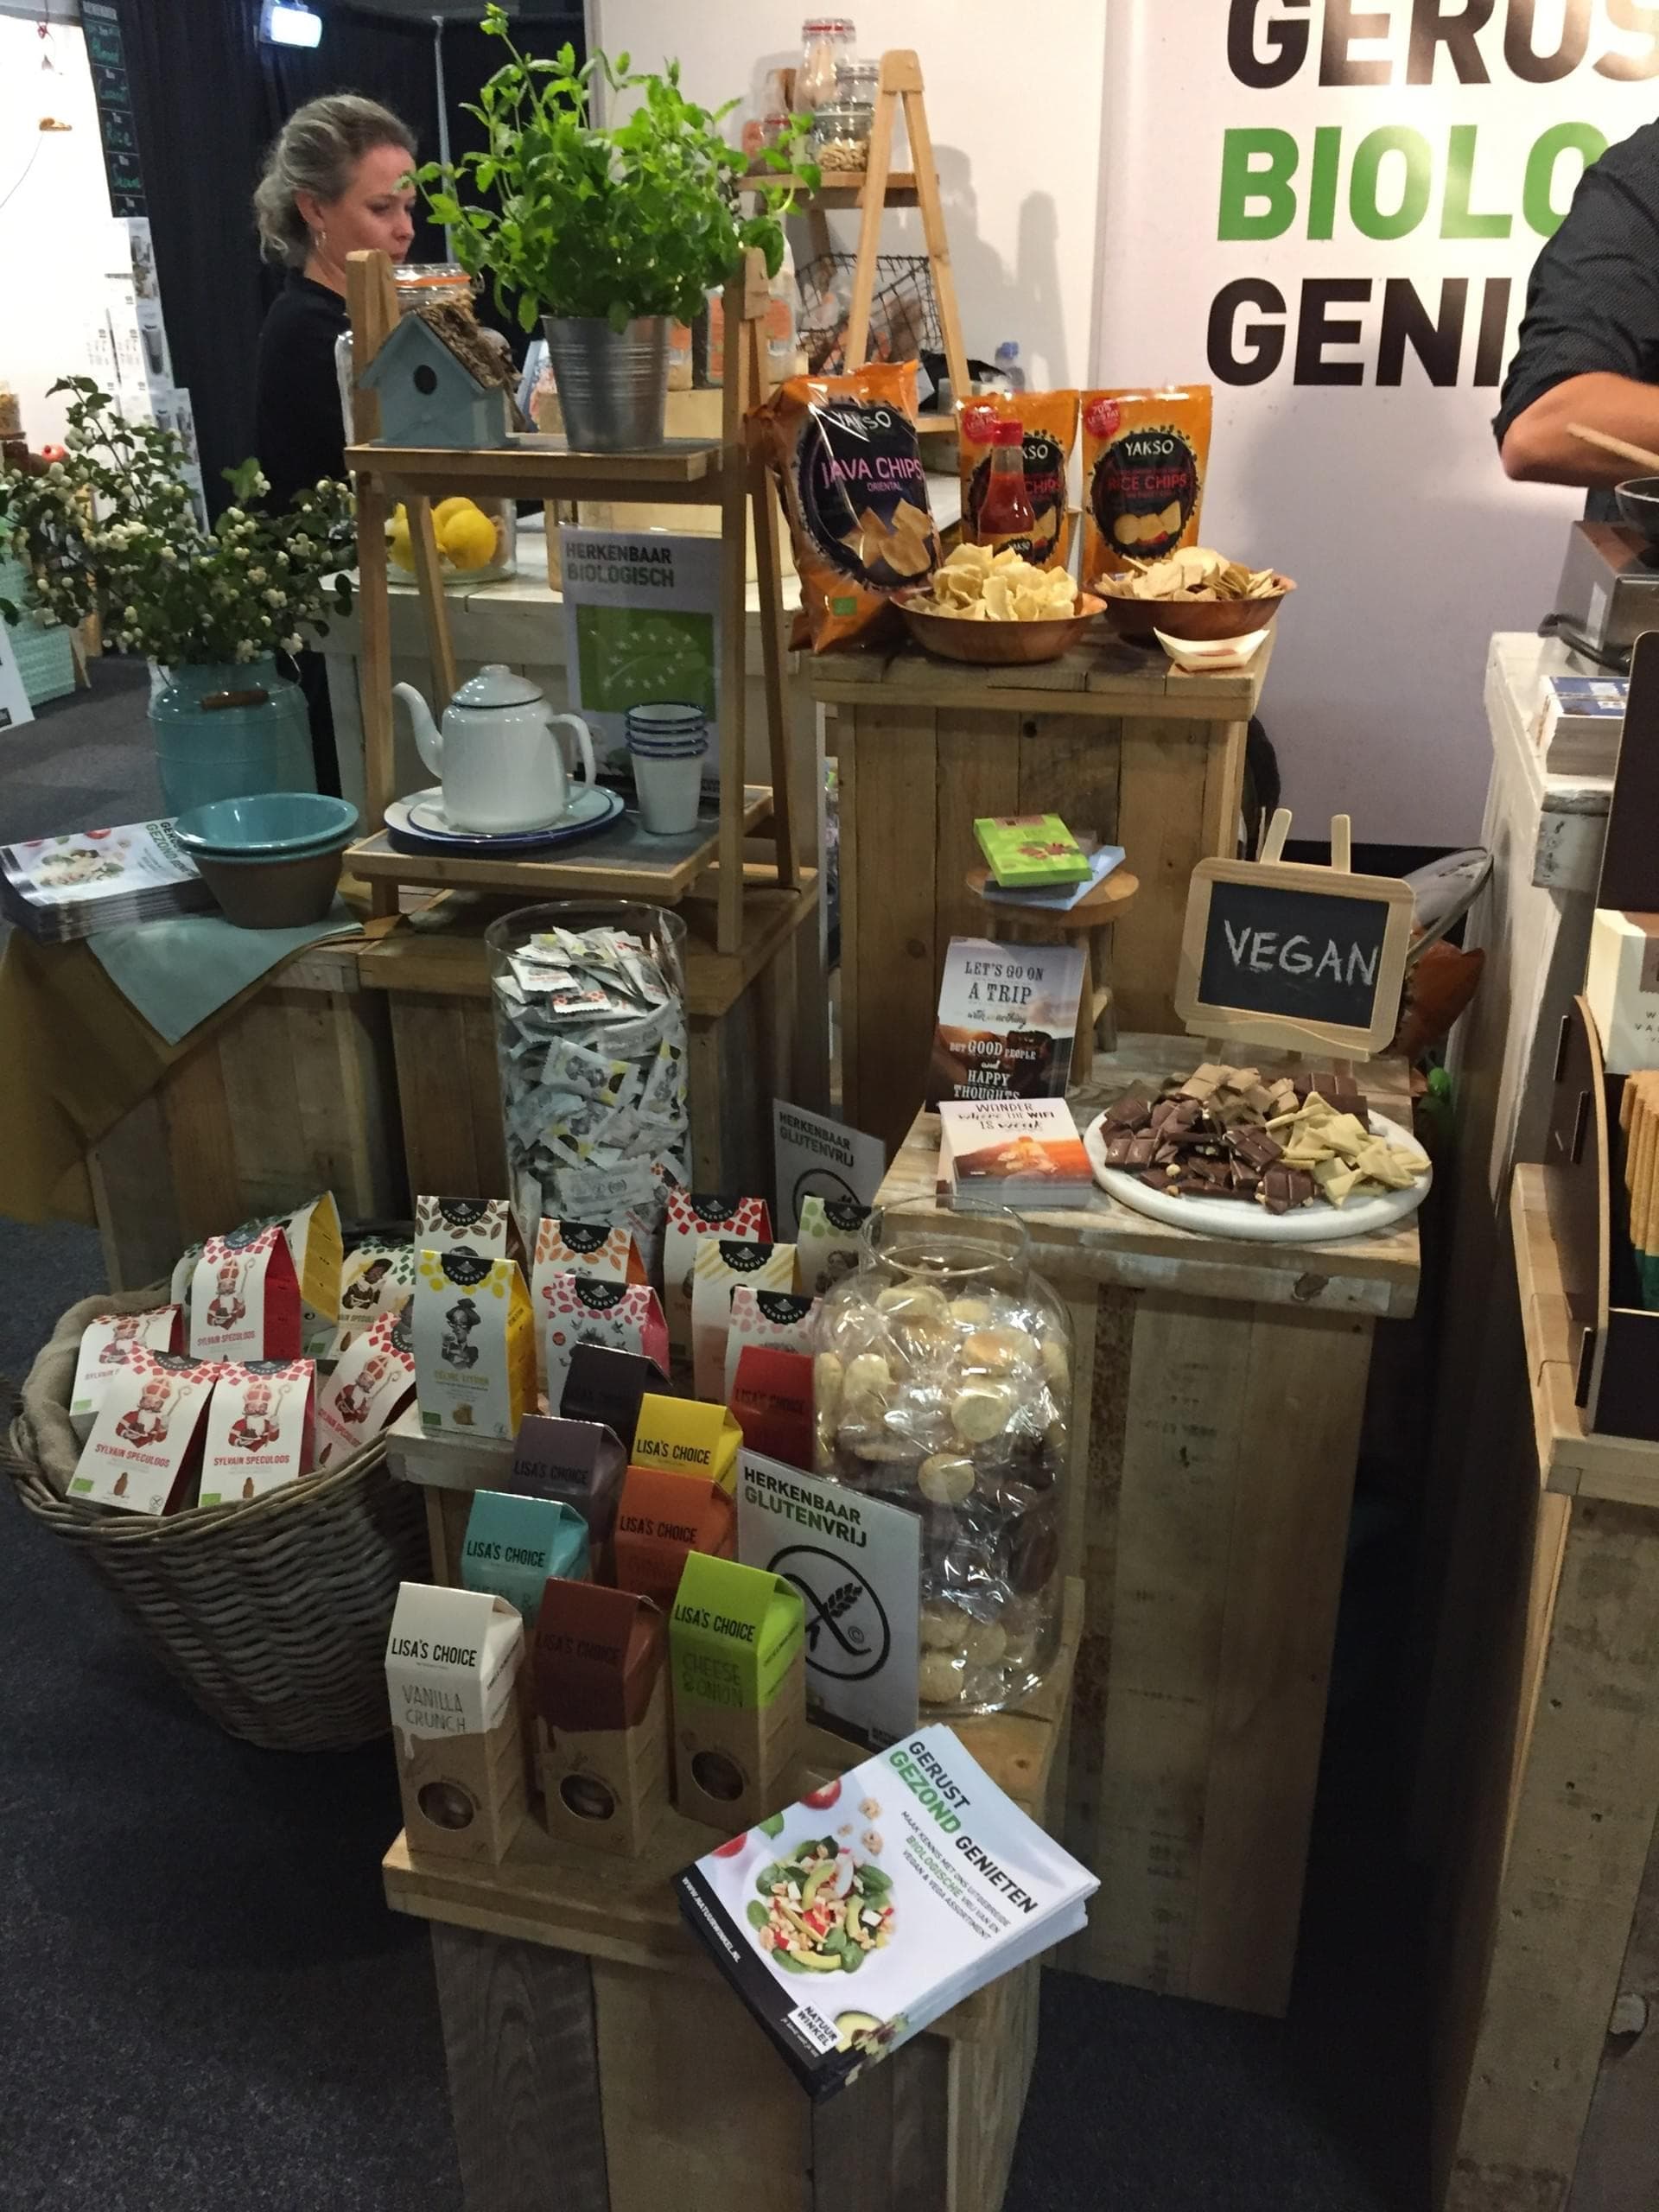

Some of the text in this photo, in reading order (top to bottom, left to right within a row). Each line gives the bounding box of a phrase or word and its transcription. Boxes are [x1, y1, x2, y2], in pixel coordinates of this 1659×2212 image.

[831, 410, 892, 431] YAKSO
[1125, 439, 1174, 456] YAKSO
[822, 457, 926, 489] JAVA CHIPS
[1145, 474, 1187, 491] CHIPS
[566, 542, 672, 564] HERKENBAAR
[567, 563, 675, 588] BIOLOGISCH
[1224, 918, 1379, 987] VEGAN
[964, 961, 1044, 982] LET'S GO ON
[968, 982, 1033, 1005] A TRIP
[968, 1039, 1003, 1057] GOOD
[1004, 1048, 1037, 1061] PEOPLE
[953, 1084, 1020, 1101] THOUGHTS
[968, 1070, 1011, 1087] HAPPY
[779, 1111, 851, 1151] HERKENBAAR
[779, 1126, 855, 1167] GLUTENVRIJ
[94, 1444, 171, 1468] SYLVAIN SPECULOOS
[213, 1455, 290, 1466] SYLVAIN SPECULOOS
[636, 1438, 712, 1465] LISA'S CHOICE
[550, 1465, 589, 1485] CHOICE
[744, 1465, 862, 1526] HERKENBAAR
[619, 1515, 699, 1545] LISA'S CHOICE
[744, 1484, 868, 1549] GLUTENVRIJ
[466, 1540, 547, 1568] LISA'S CHOICE
[674, 1604, 756, 1643] LISA'S CHOICE
[391, 1637, 429, 1660] LISA'S
[432, 1644, 478, 1668] CHOICE
[682, 1653, 741, 1683] CHEESE
[401, 1684, 464, 1713] VANILLA
[405, 1708, 467, 1733] CRUNCH
[908, 1741, 971, 1810] GERUST
[888, 1750, 1039, 1915] GEZOND GENIETEN
[904, 1834, 964, 1898] BIOLOGISCHE
[917, 1831, 945, 1860] KENNIS
[940, 1858, 957, 1874] MET
[953, 1872, 969, 1889] ONS
[967, 1883, 1011, 1929] UITGEBREIDE
[901, 1849, 925, 1875] VEGAN
[944, 1894, 990, 1943] ASSORTIMENT
[682, 1876, 741, 1963] WWW.NATUURWINKEL.NL
[797, 2011, 830, 2047] WINKEL
[804, 2005, 838, 2043] NATUUR
